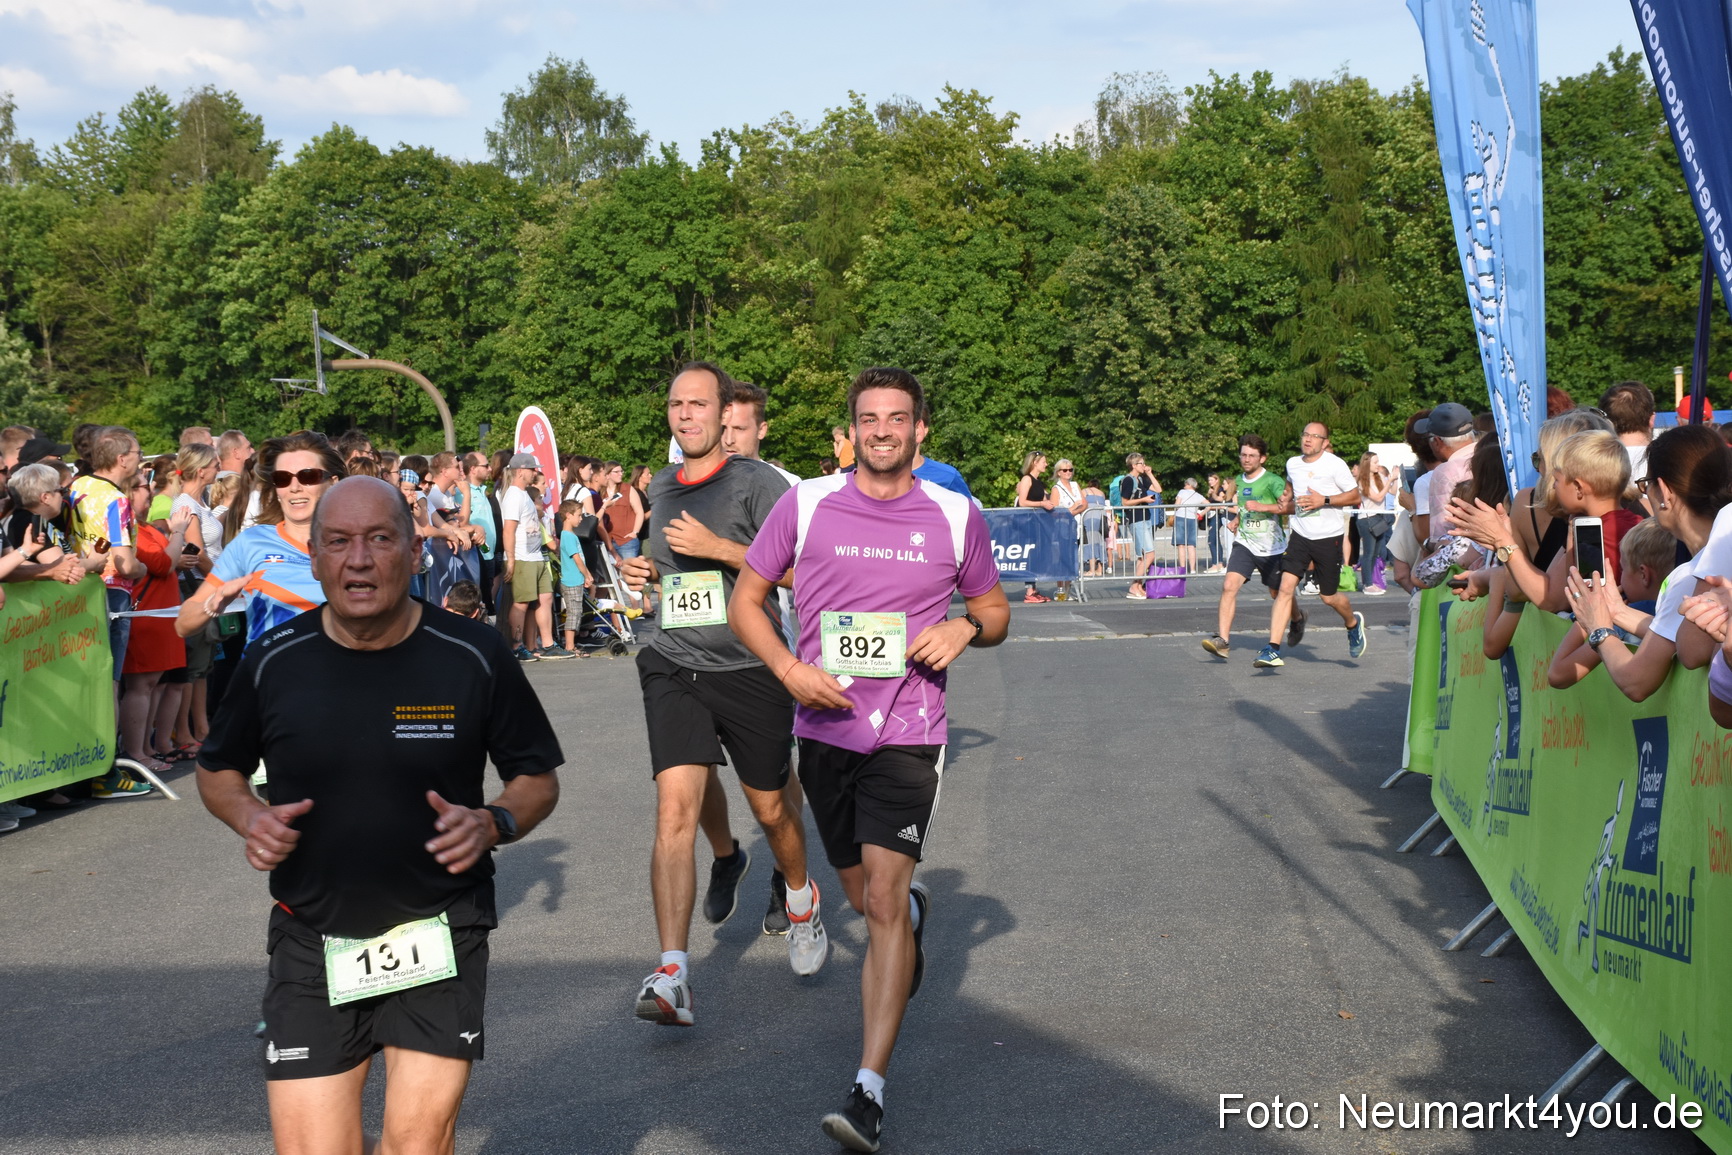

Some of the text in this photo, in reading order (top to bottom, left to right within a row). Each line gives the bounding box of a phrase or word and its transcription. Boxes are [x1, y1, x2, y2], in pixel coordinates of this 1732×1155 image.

[1246, 520, 1260, 528] 570
[834, 545, 928, 563] WIR SIND LILA.
[990, 540, 1036, 560] her
[668, 590, 712, 613] 1481
[23, 636, 56, 673] laufen
[839, 636, 886, 659] 892
[897, 831, 920, 844] adidas
[356, 941, 420, 976] 131
[1603, 949, 1642, 984] neumarkt
[358, 964, 426, 985] Feierle Roland
